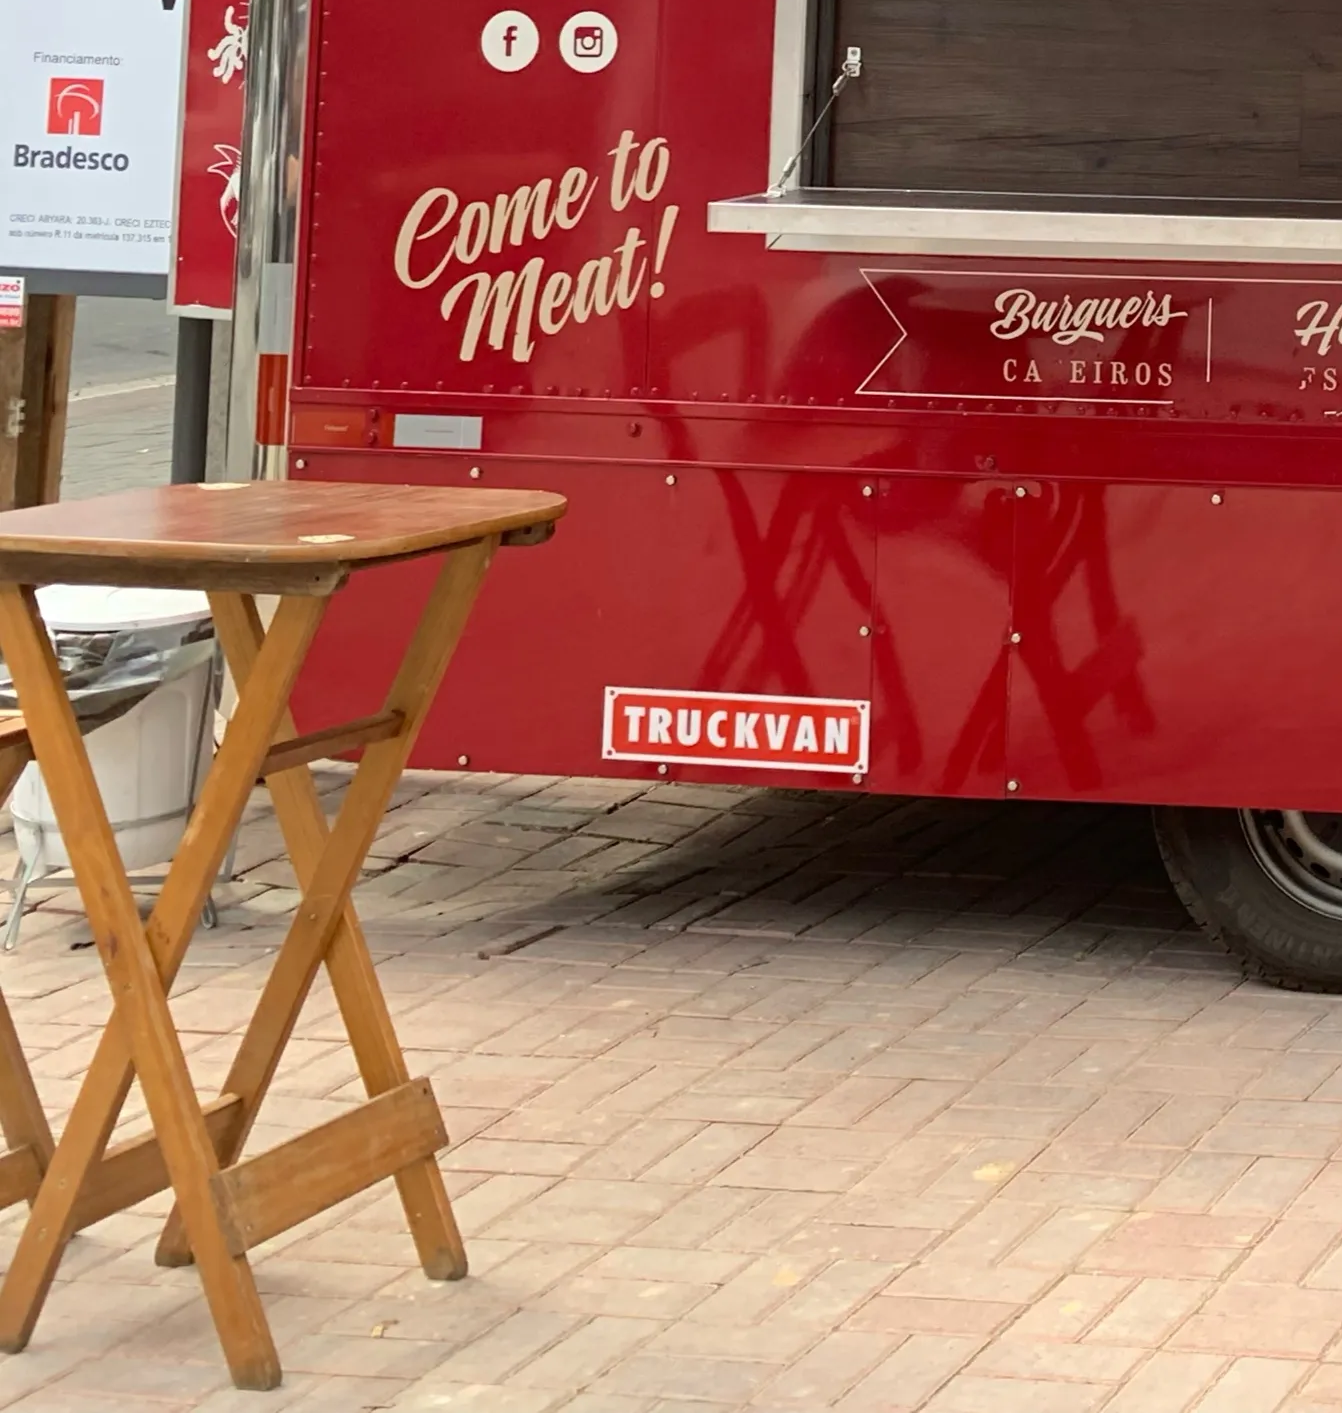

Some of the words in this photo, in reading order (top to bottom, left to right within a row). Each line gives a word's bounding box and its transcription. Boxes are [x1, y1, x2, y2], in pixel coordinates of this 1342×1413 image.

[33, 51, 123, 67] Financiamento:
[13, 144, 129, 172] Bradesco
[394, 167, 599, 290] Come
[607, 129, 670, 212] to
[441, 204, 680, 363] Meat!
[990, 288, 1188, 345] Burguers
[624, 705, 850, 755] TRUCKVAN
